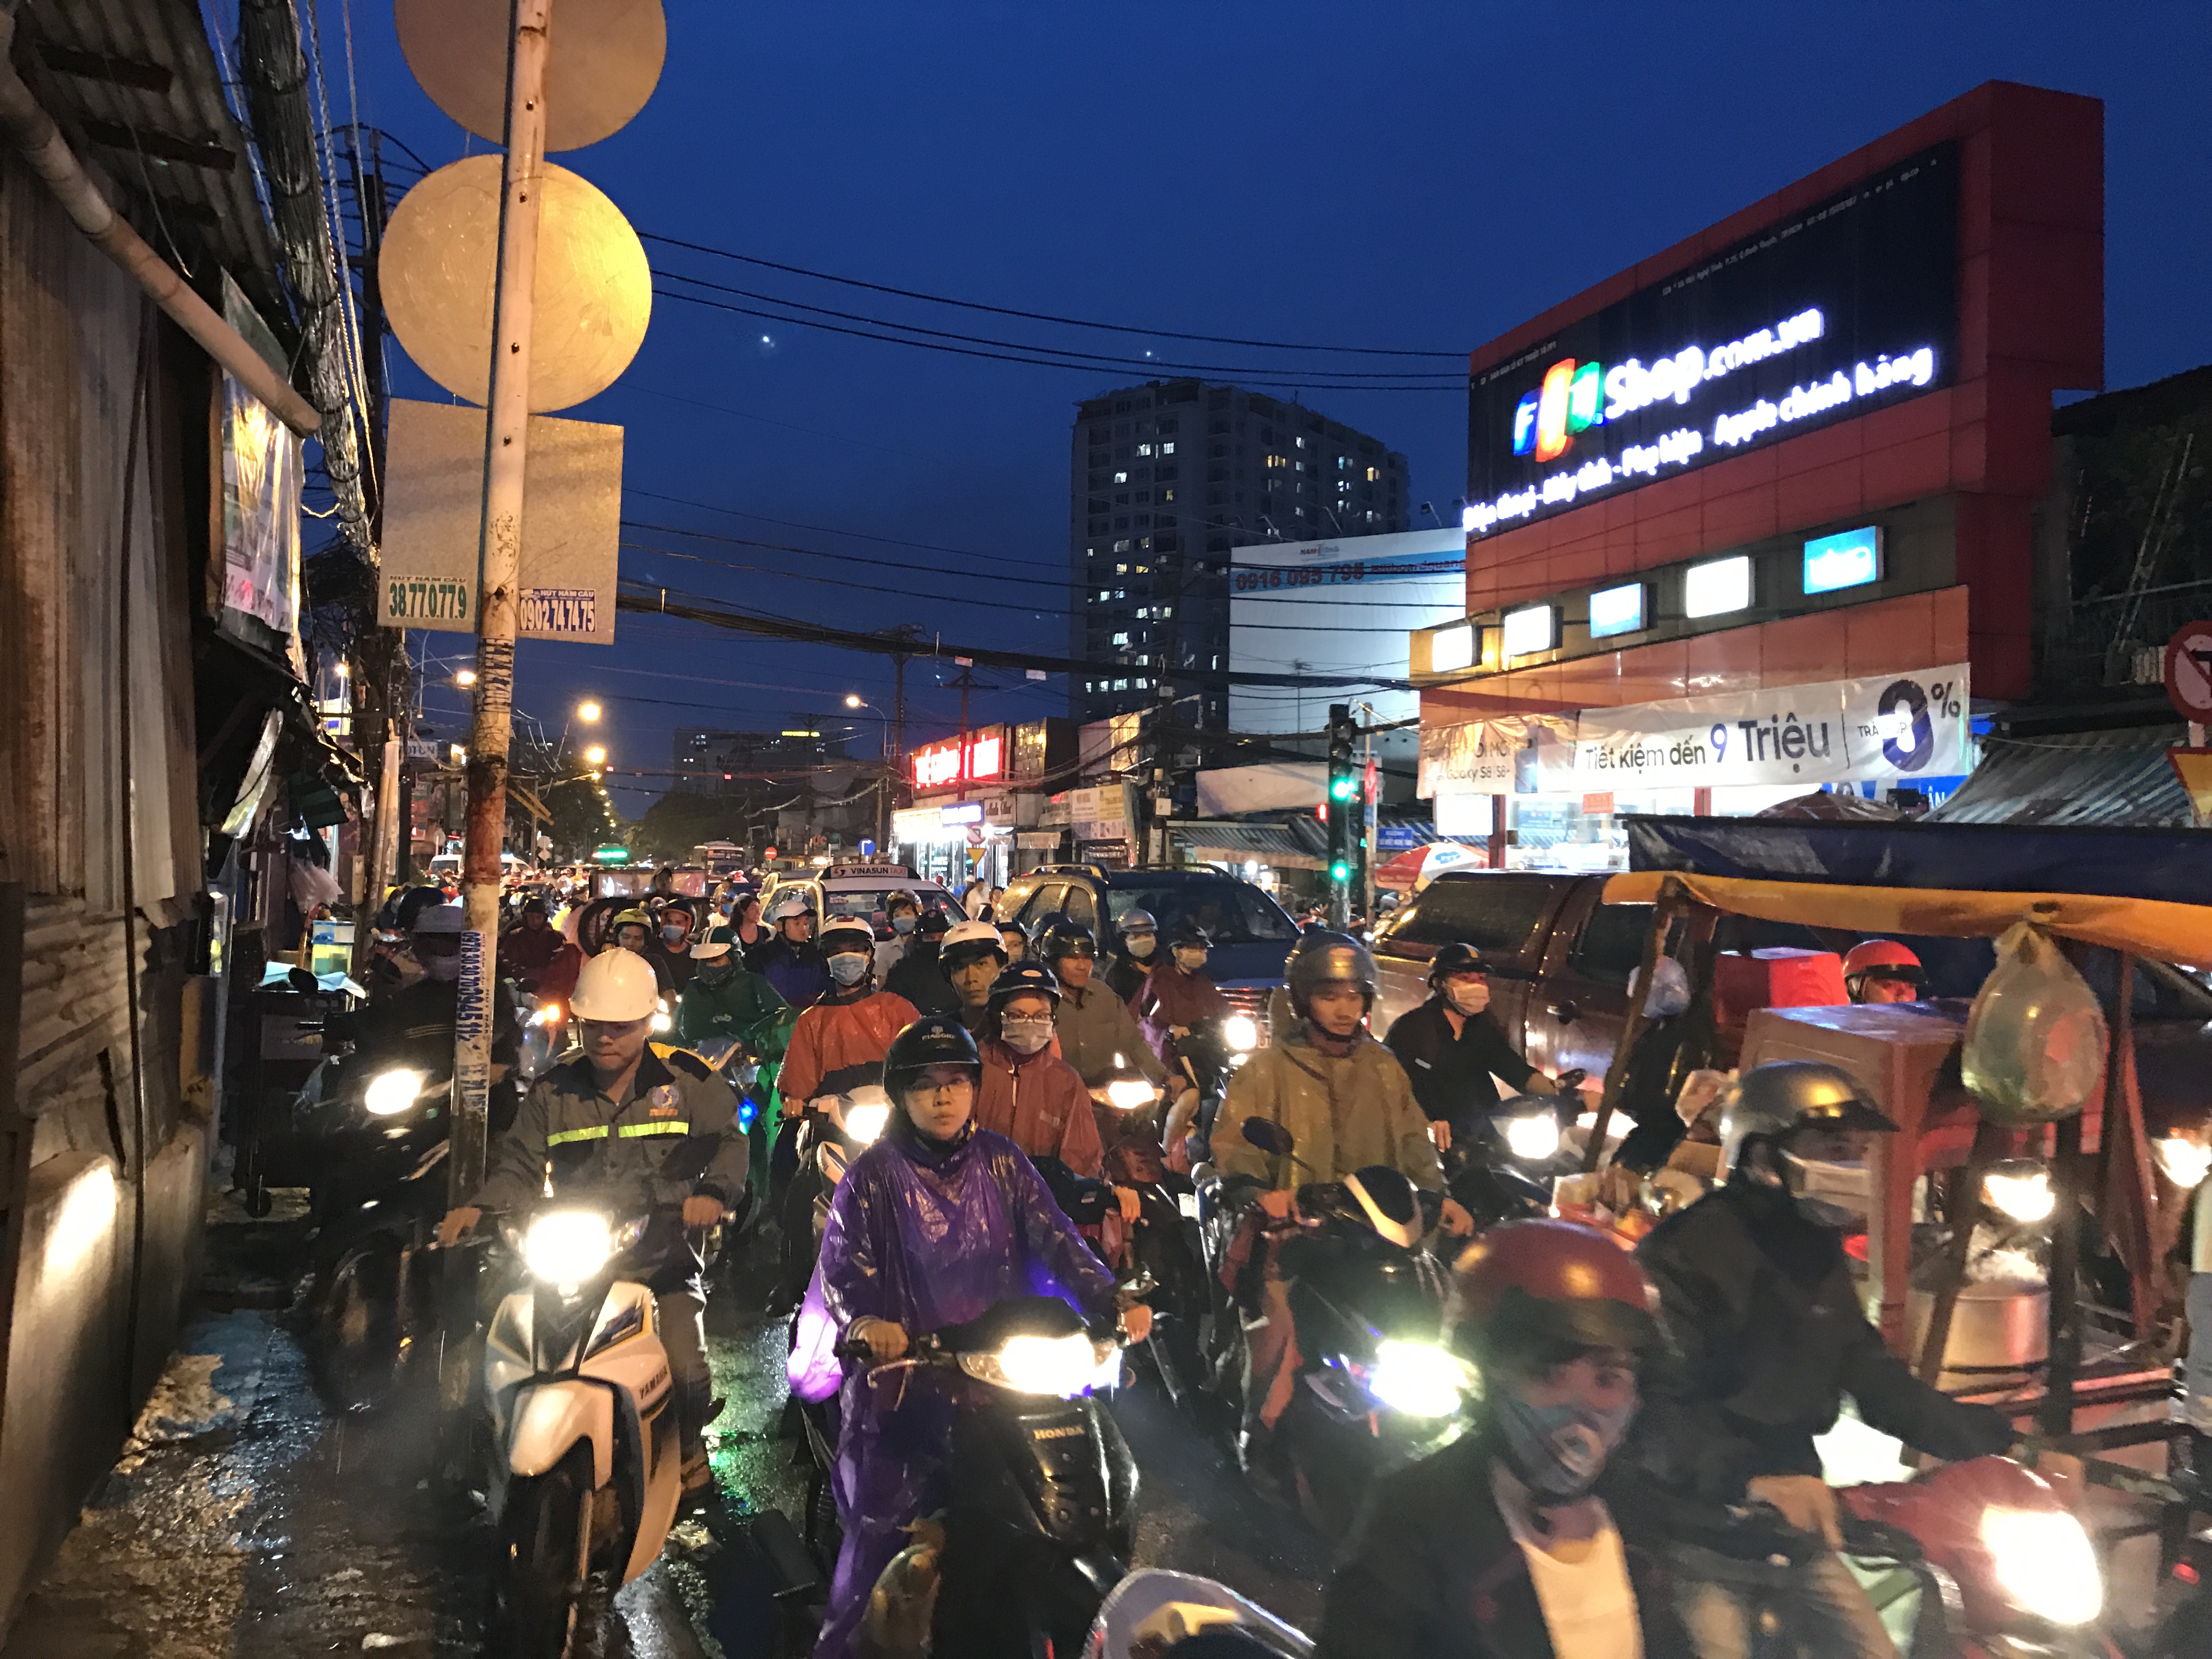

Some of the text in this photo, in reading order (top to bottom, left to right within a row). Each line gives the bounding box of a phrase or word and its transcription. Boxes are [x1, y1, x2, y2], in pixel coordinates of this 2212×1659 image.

[1236, 570, 1281, 590] 0916
[390, 583, 466, 618] 38.77.0.77.9
[1585, 712, 1830, 774] Tiết kiệm đến 9 Triệu
[1034, 1426, 1084, 1440] HONDA
